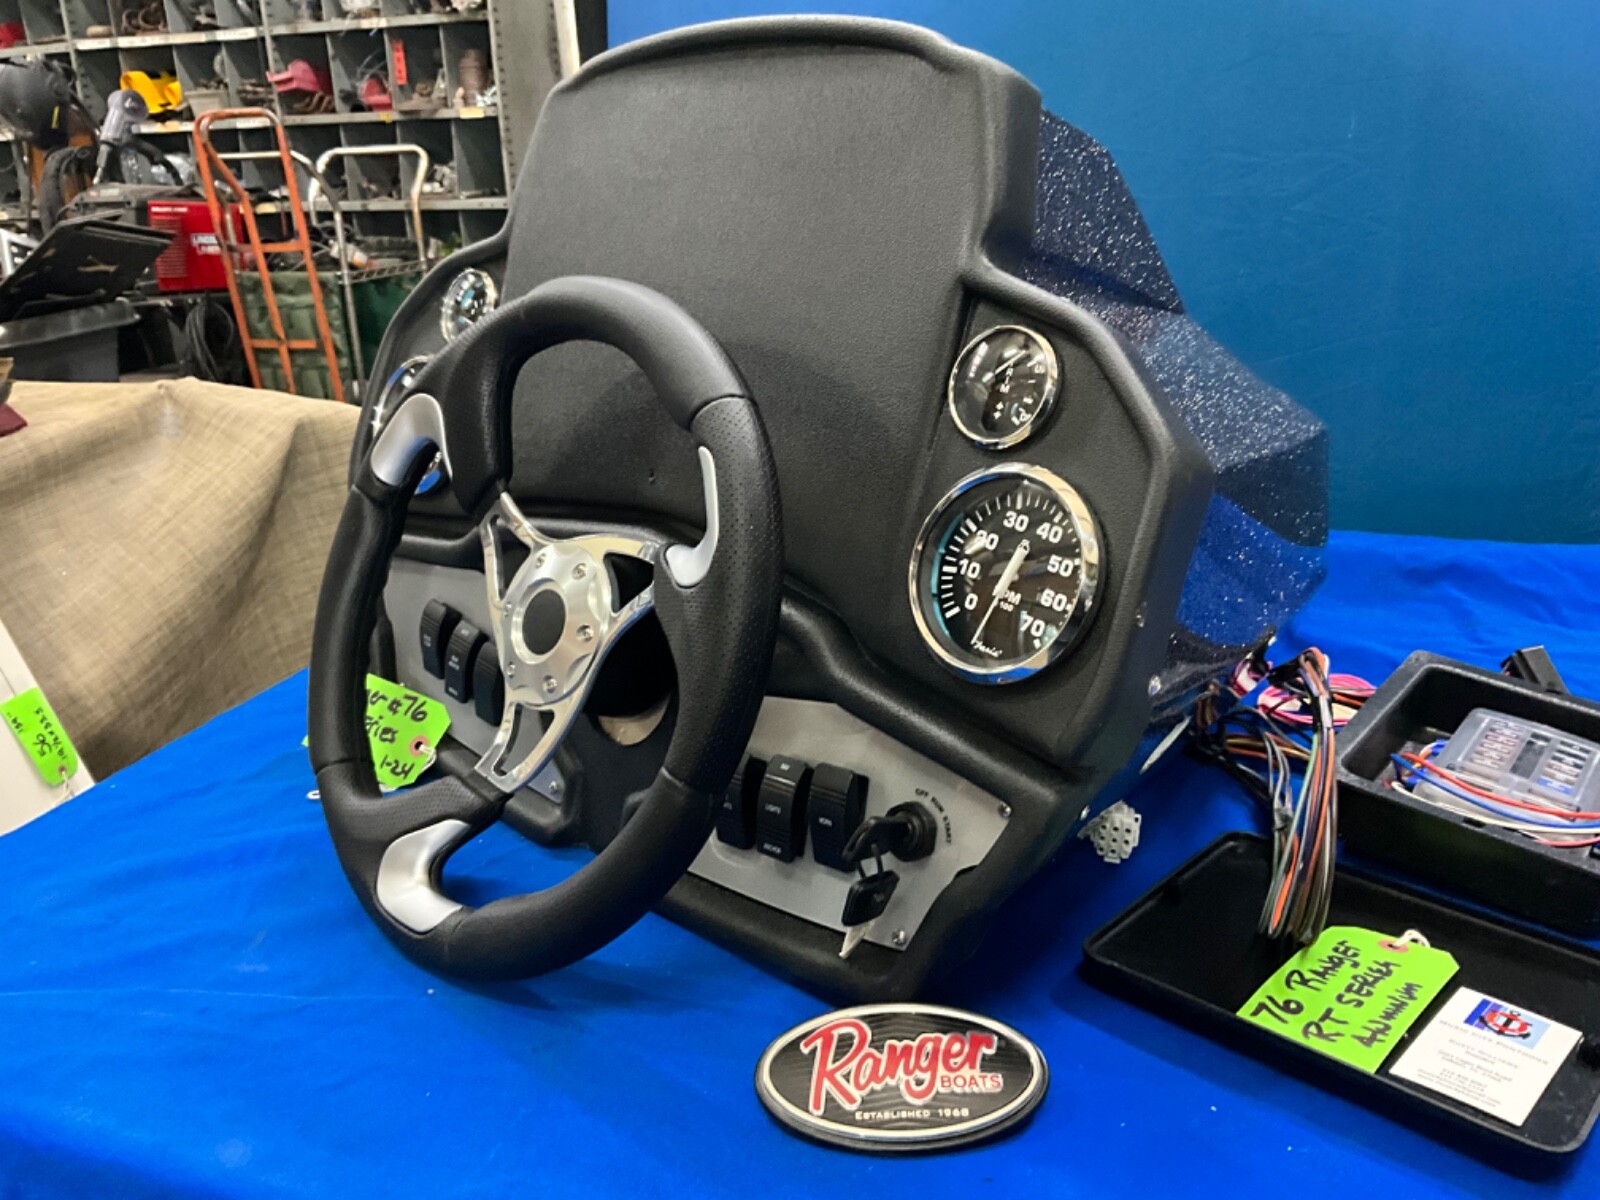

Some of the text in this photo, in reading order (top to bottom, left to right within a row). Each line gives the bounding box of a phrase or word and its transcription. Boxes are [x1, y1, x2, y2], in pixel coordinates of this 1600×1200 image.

[1003, 511, 1029, 532] 30
[1036, 522, 1062, 543] 40
[959, 559, 980, 579] 10
[1047, 555, 1073, 577] 50
[964, 593, 979, 610] 0
[1040, 589, 1067, 612] 60
[1020, 614, 1045, 637] 70
[1250, 995, 1304, 1024] 76
[1302, 1007, 1349, 1043] RT
[801, 1018, 998, 1115] Ranger
[939, 1074, 1002, 1089] BOATS
[855, 1110, 930, 1120] ESTABLISHED
